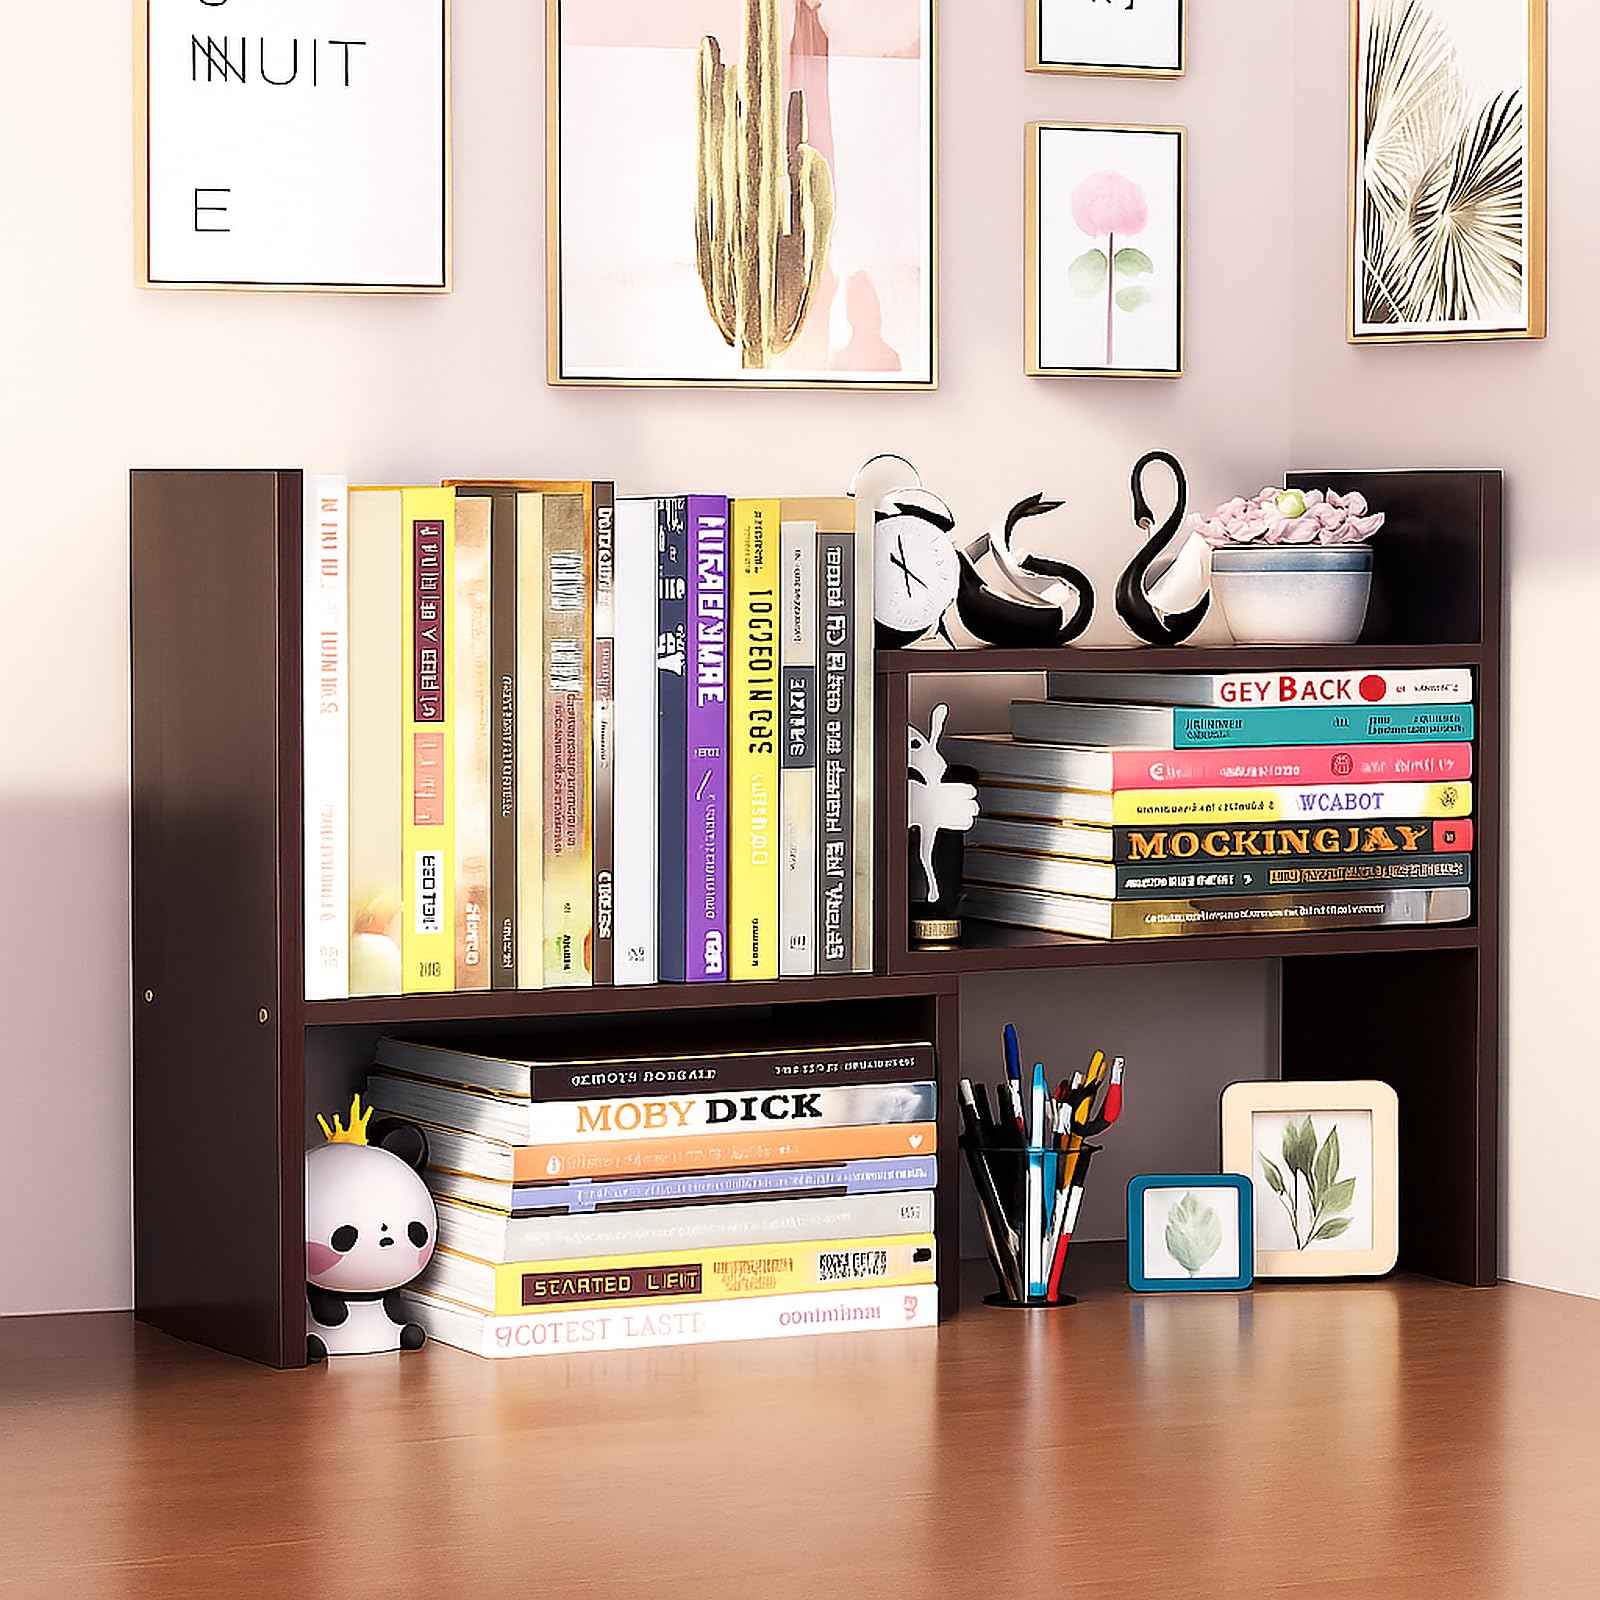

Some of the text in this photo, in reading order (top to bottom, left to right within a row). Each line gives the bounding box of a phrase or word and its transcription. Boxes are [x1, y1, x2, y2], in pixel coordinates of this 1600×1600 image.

[194, 187, 231, 232] E
[1220, 675, 1352, 702] GEY BACK
[1299, 792, 1385, 812] WCABOT
[1128, 825, 1429, 860] MOCKINGJAY
[576, 1093, 823, 1133] MOBY DICK
